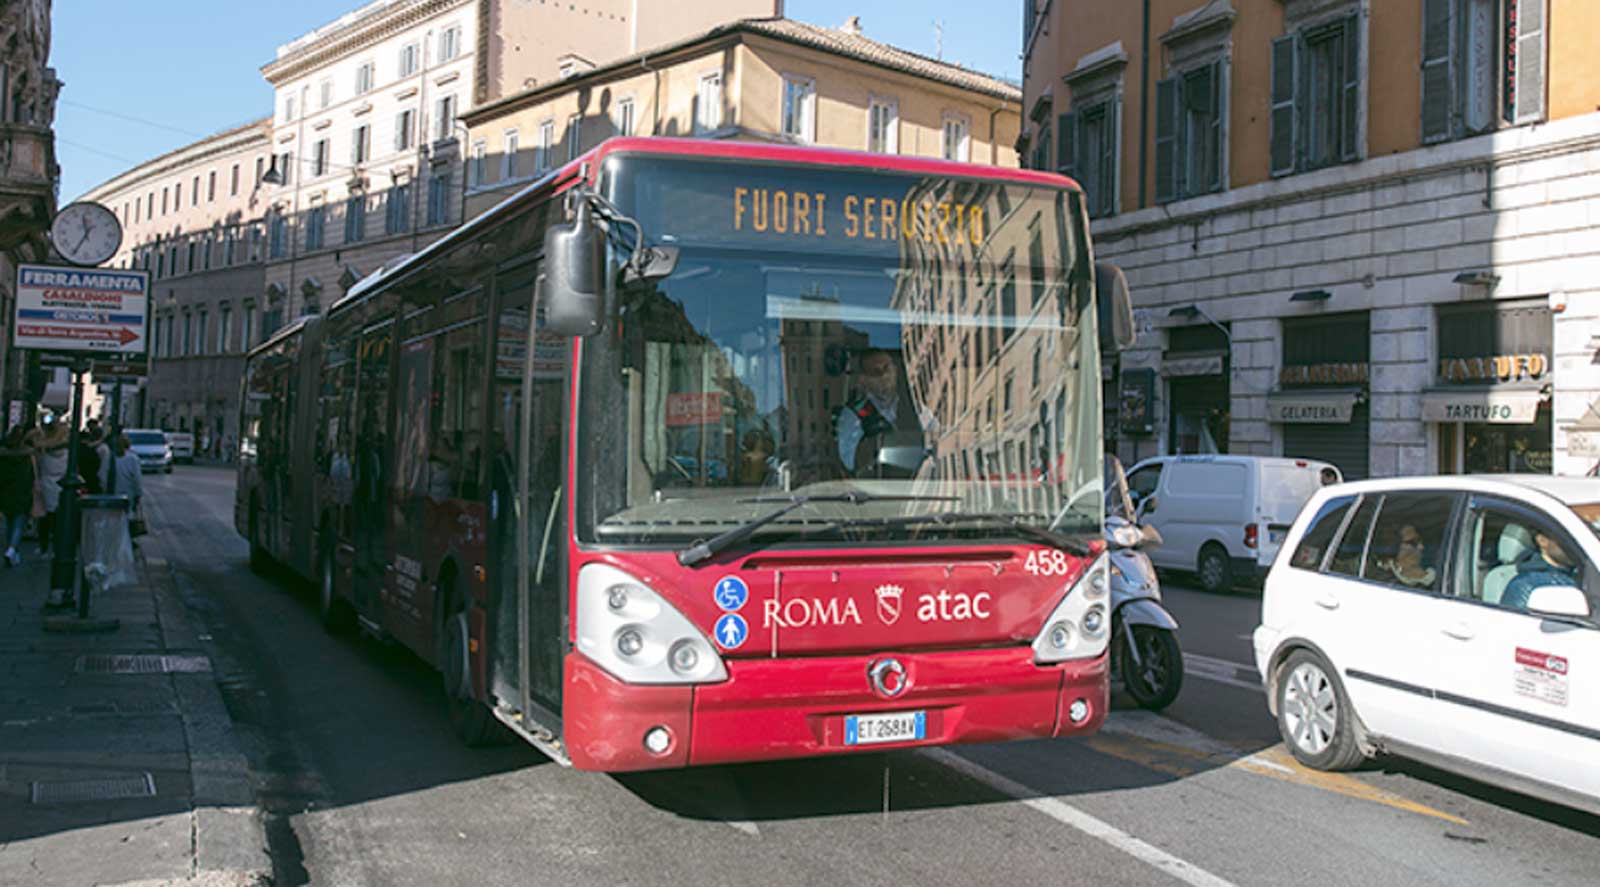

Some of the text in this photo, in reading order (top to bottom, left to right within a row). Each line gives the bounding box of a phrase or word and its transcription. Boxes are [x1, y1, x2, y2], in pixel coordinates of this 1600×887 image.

[735, 187, 984, 246] FUORI SERVIZIO
[24, 271, 142, 290] FERRAMENTA
[1280, 405, 1338, 419] GELATERIA
[1445, 404, 1512, 419] TARTUFO
[1024, 550, 1068, 577] 458
[763, 590, 991, 628] ROMA atac
